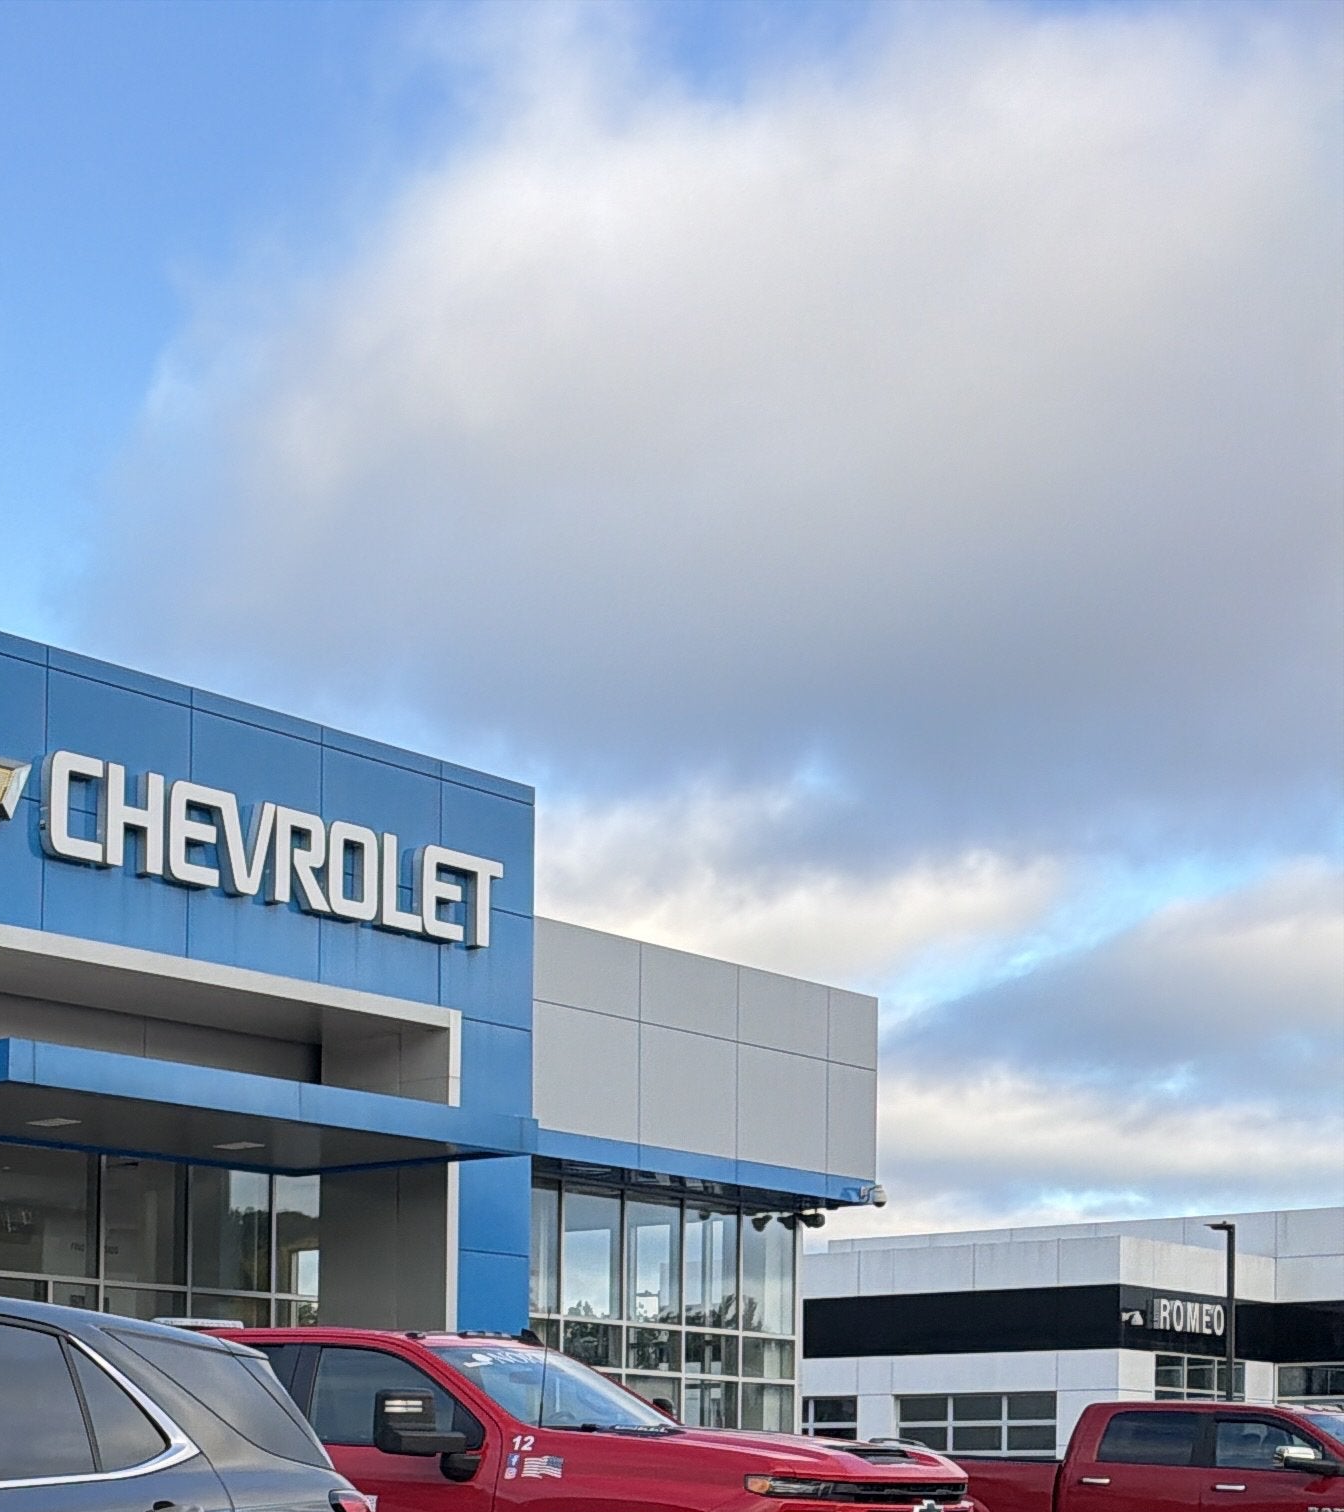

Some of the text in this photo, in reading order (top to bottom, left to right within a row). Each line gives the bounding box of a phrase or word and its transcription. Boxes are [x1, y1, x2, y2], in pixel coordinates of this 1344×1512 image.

[41, 750, 503, 948] CHEVROLET
[1154, 1299, 1224, 1336] ROMEO
[512, 1435, 535, 1451] 12
